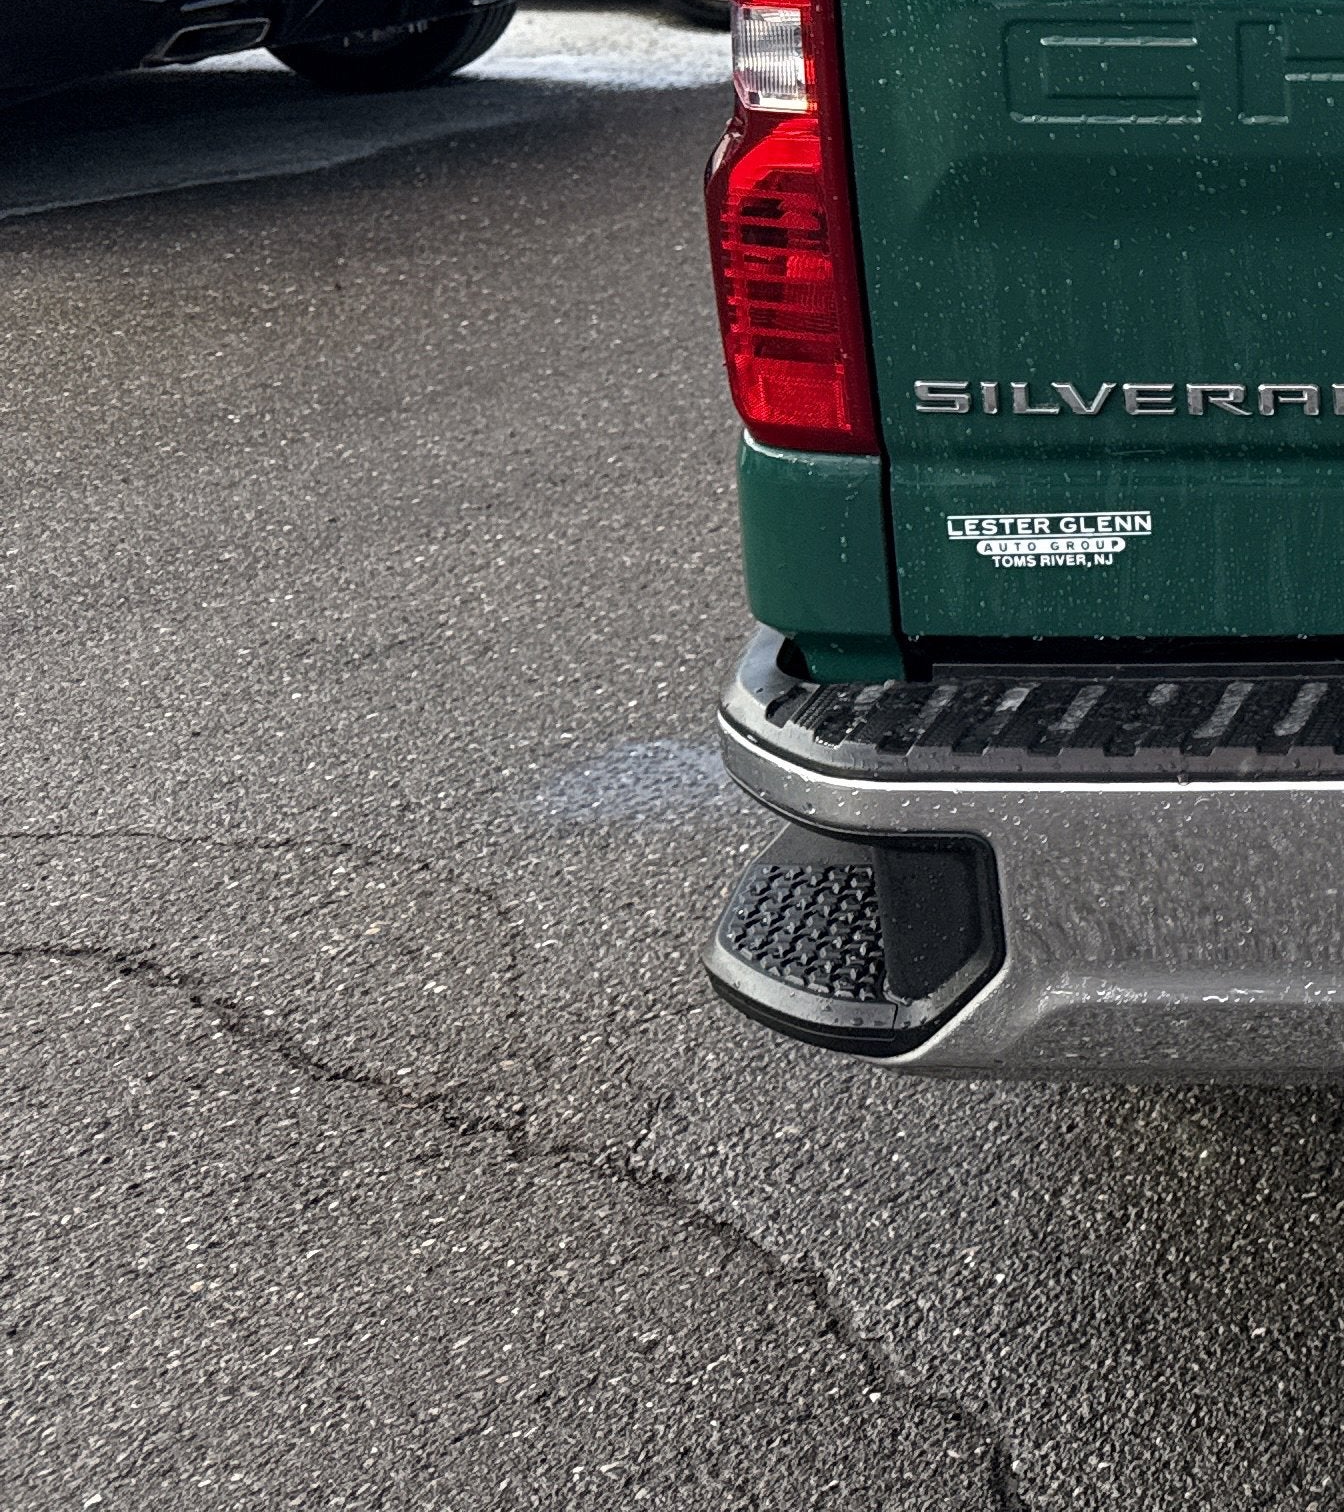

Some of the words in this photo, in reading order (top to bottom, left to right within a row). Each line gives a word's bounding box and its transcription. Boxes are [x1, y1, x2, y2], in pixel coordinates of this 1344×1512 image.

[948, 518, 1050, 535] LESTER
[1060, 515, 1152, 533] GLENN
[984, 542, 1036, 552] AUTO
[1050, 540, 1119, 551] GROUP
[992, 555, 1036, 567] TOMS
[1040, 554, 1092, 567] RIVER,
[1094, 553, 1113, 565] NJ
